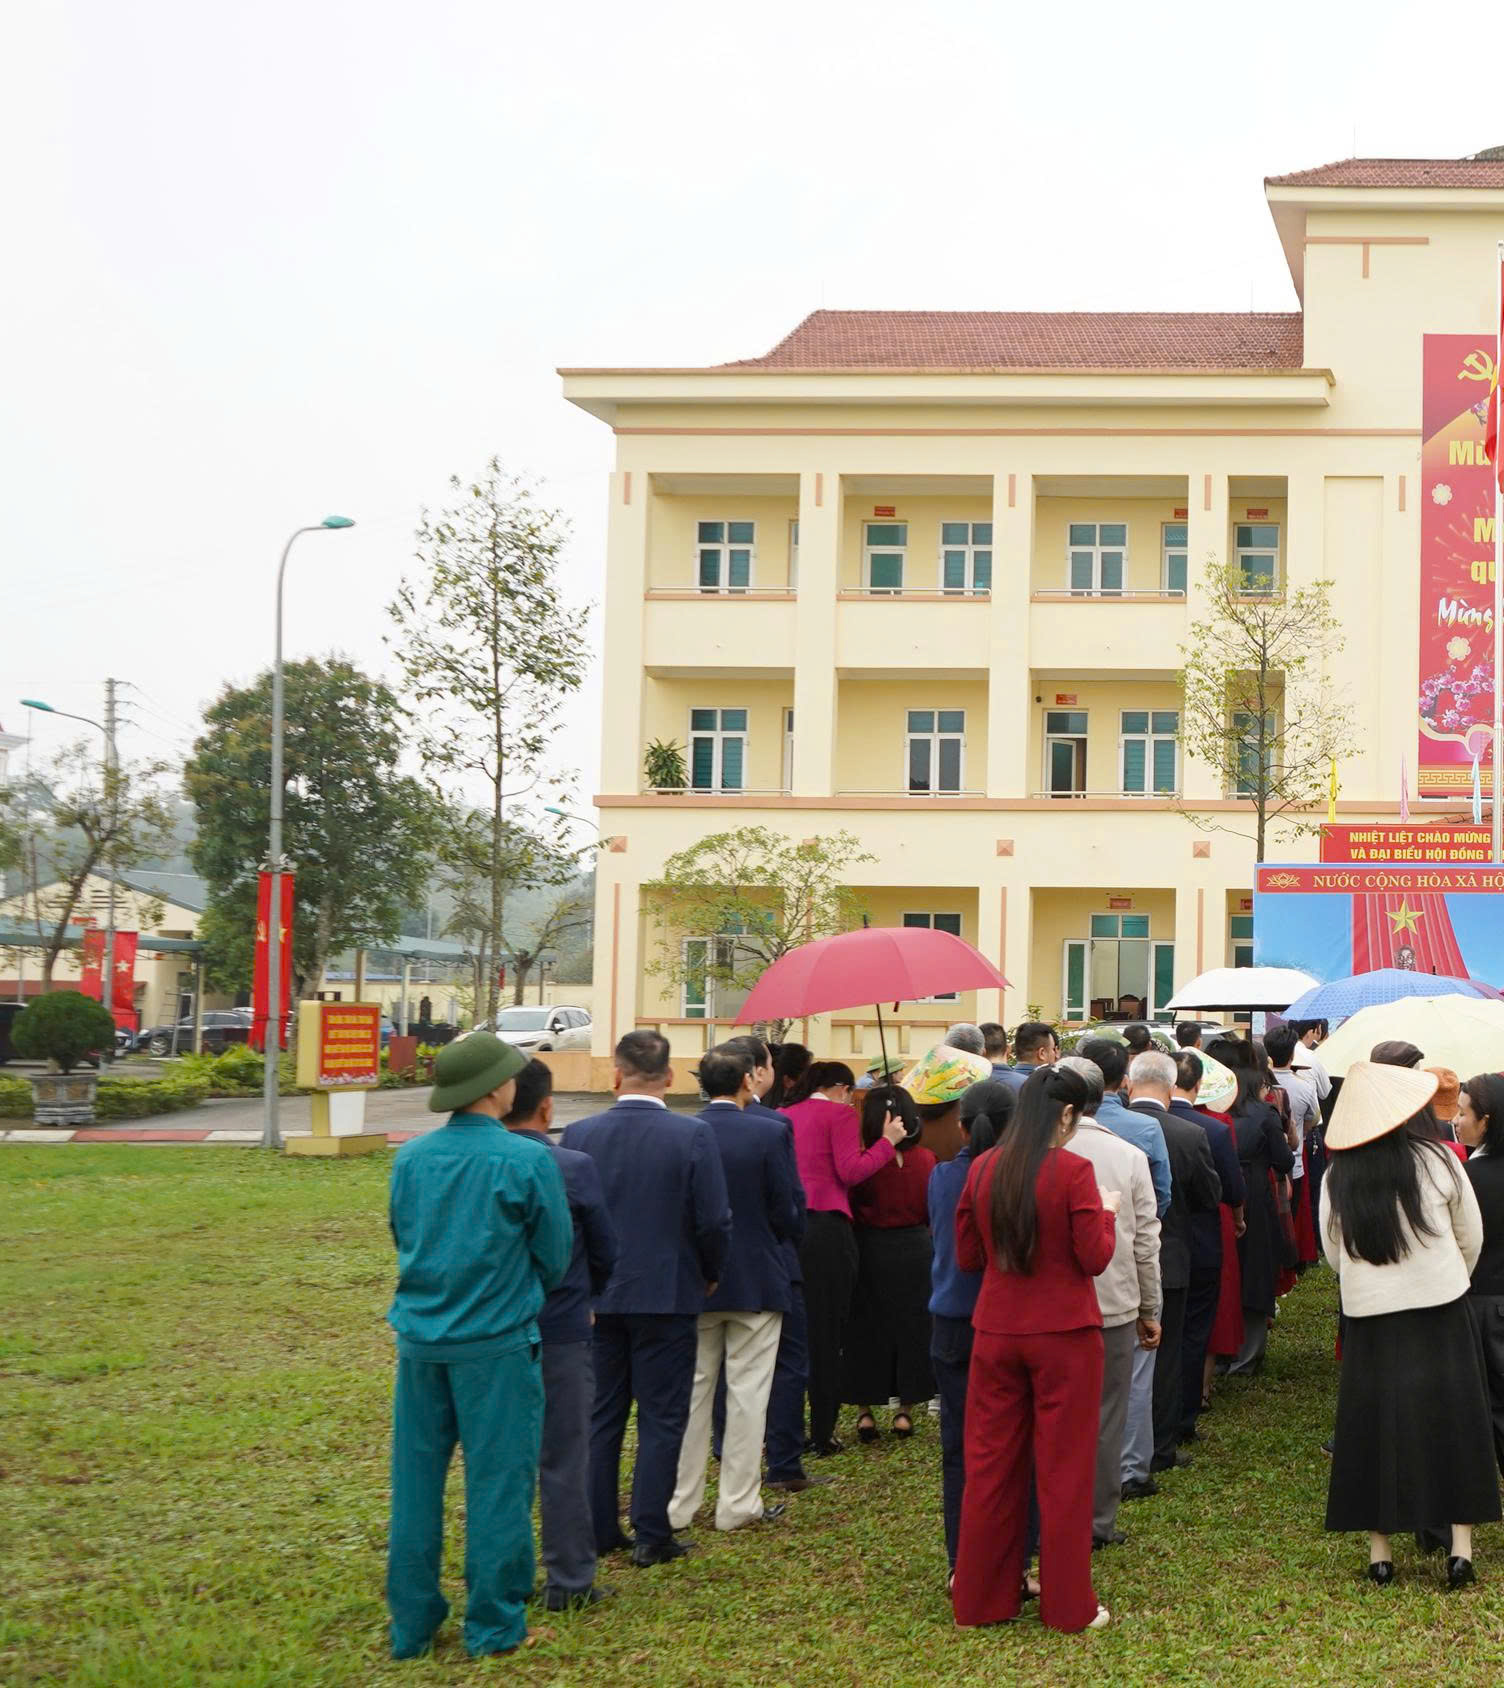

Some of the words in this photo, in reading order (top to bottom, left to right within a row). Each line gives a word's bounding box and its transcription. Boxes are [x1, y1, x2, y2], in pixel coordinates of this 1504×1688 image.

[1350, 830, 1385, 844] NHIỆT
[1389, 830, 1413, 845] LIỆT
[1418, 831, 1450, 843] CHÀO
[1454, 831, 1491, 844] MỪNG
[1351, 848, 1366, 860] VÀ
[1370, 848, 1390, 862] ĐẠI
[1394, 845, 1422, 860] BIỂU
[1426, 847, 1446, 862] HỘI
[1450, 847, 1484, 860] ĐỒNG
[1313, 871, 1361, 887] NƯỚC
[1365, 871, 1411, 891] CỘNG
[1416, 872, 1452, 888] HÒA
[1455, 872, 1478, 888] XÃ
